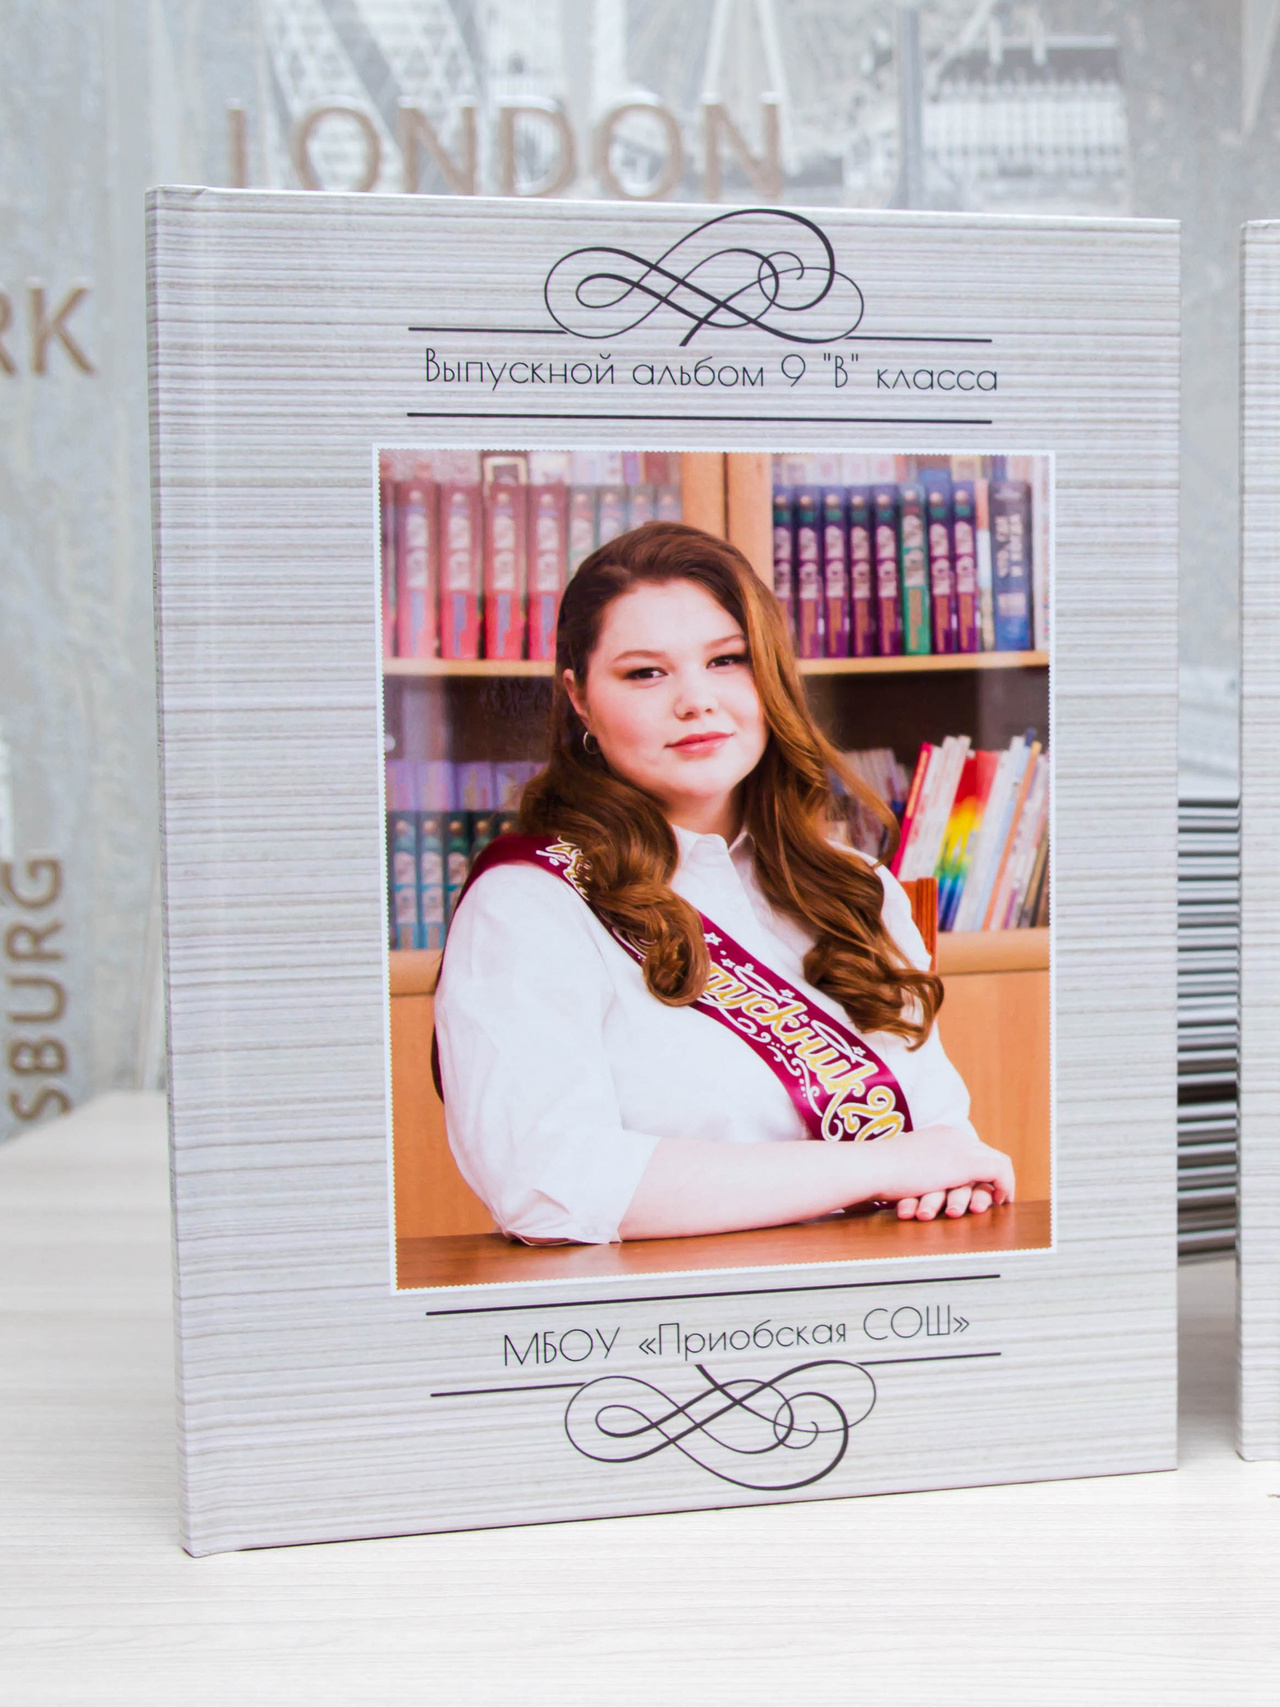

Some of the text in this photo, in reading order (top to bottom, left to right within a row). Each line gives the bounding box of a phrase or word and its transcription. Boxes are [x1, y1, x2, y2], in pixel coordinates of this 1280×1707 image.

[425, 347, 614, 391] Выпускной
[632, 355, 764, 387] альбом
[780, 353, 806, 387] 9
[876, 368, 998, 391] класса
[504, 1304, 970, 1367] МБОУ «Приобская СОШ»
